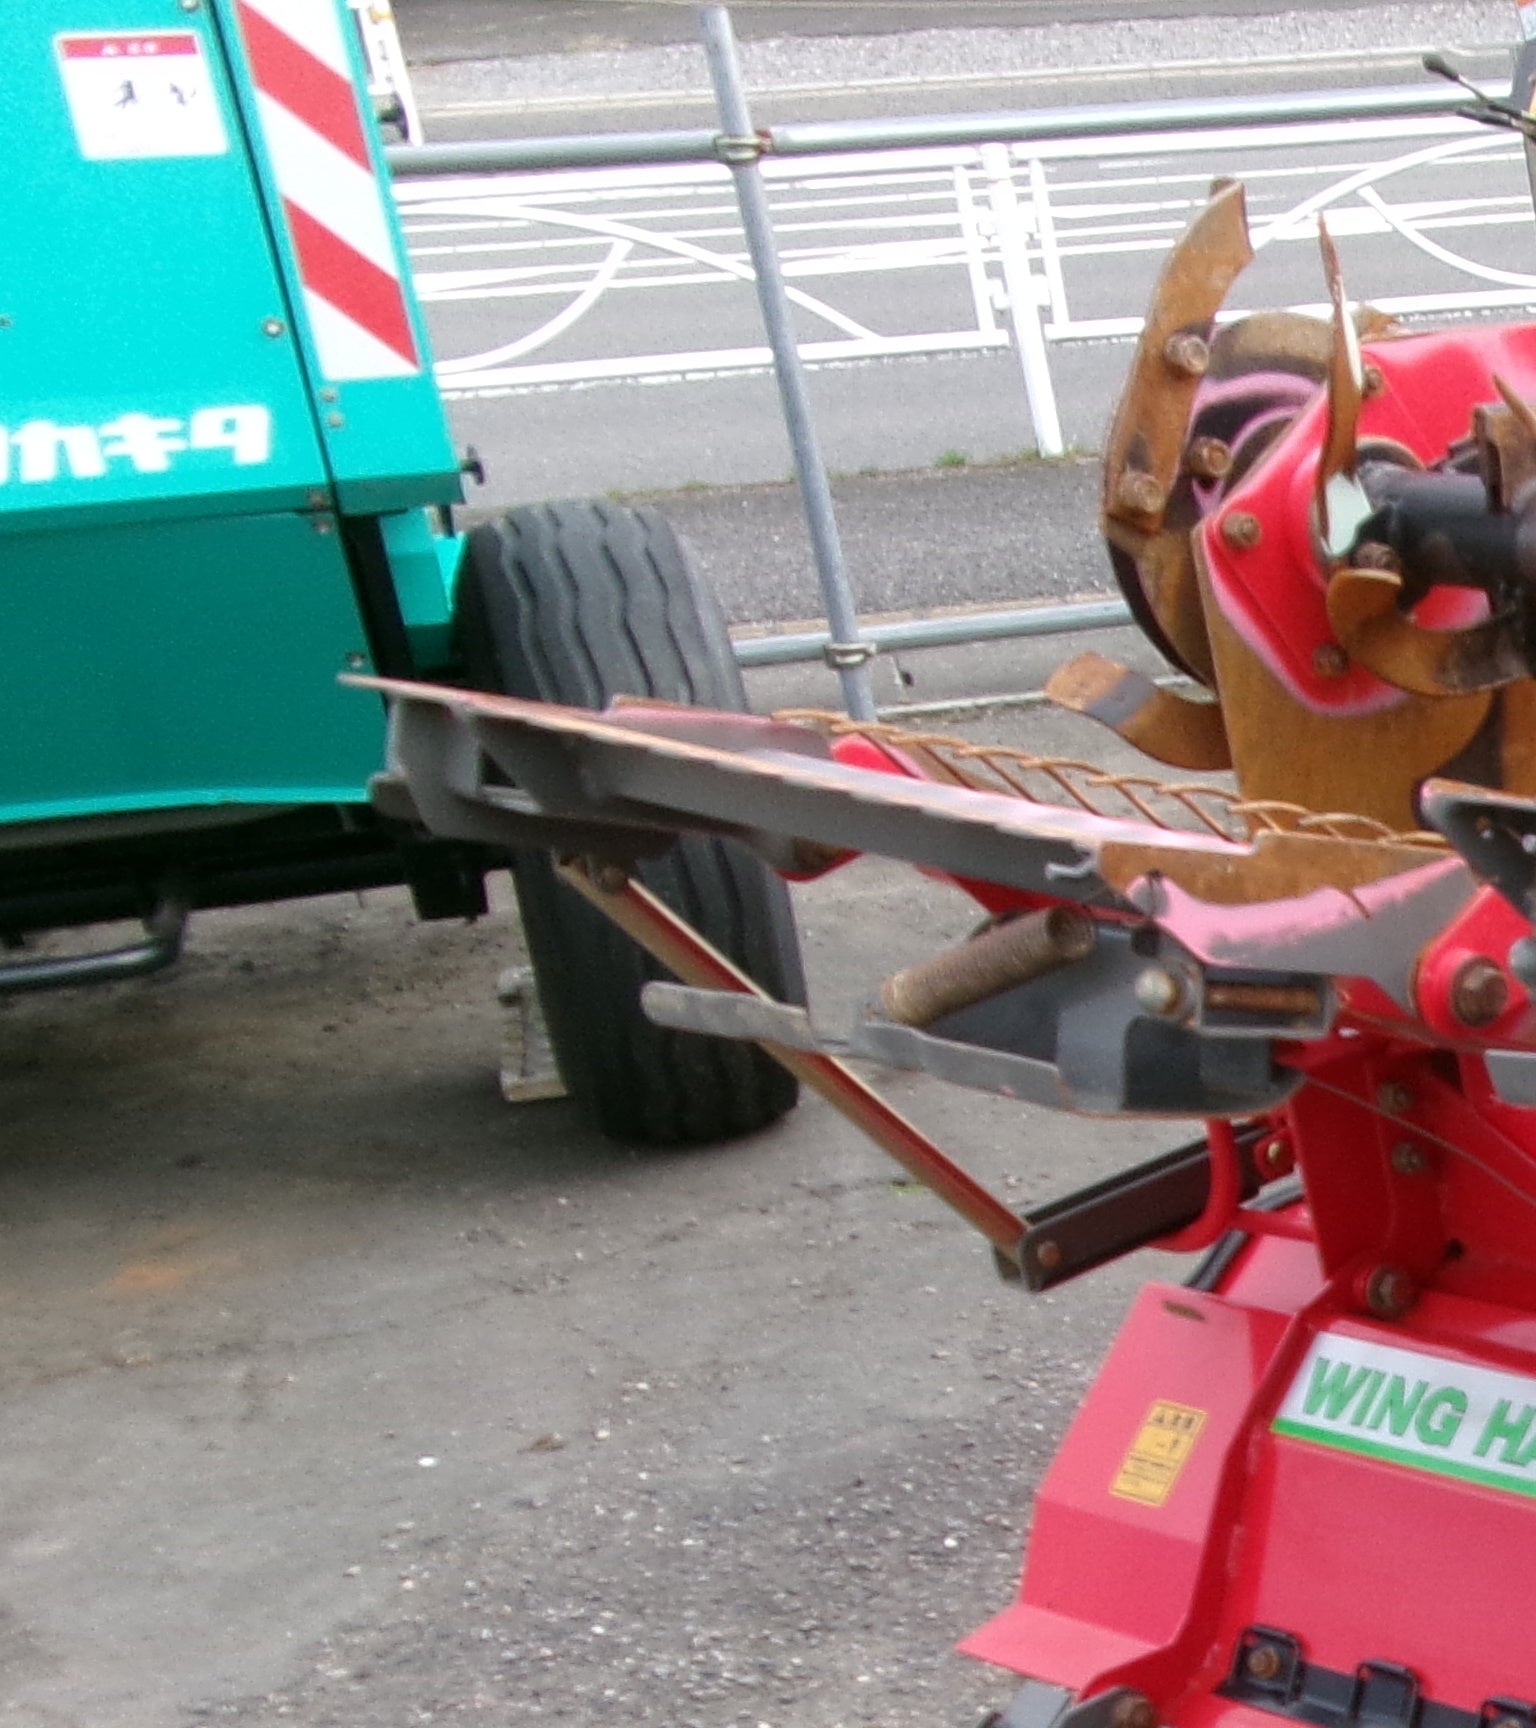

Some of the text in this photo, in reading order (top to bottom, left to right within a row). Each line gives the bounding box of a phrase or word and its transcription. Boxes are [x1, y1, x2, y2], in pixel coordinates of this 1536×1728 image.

[0, 404, 269, 484] カキタ
[1302, 1357, 1468, 1447] WING
